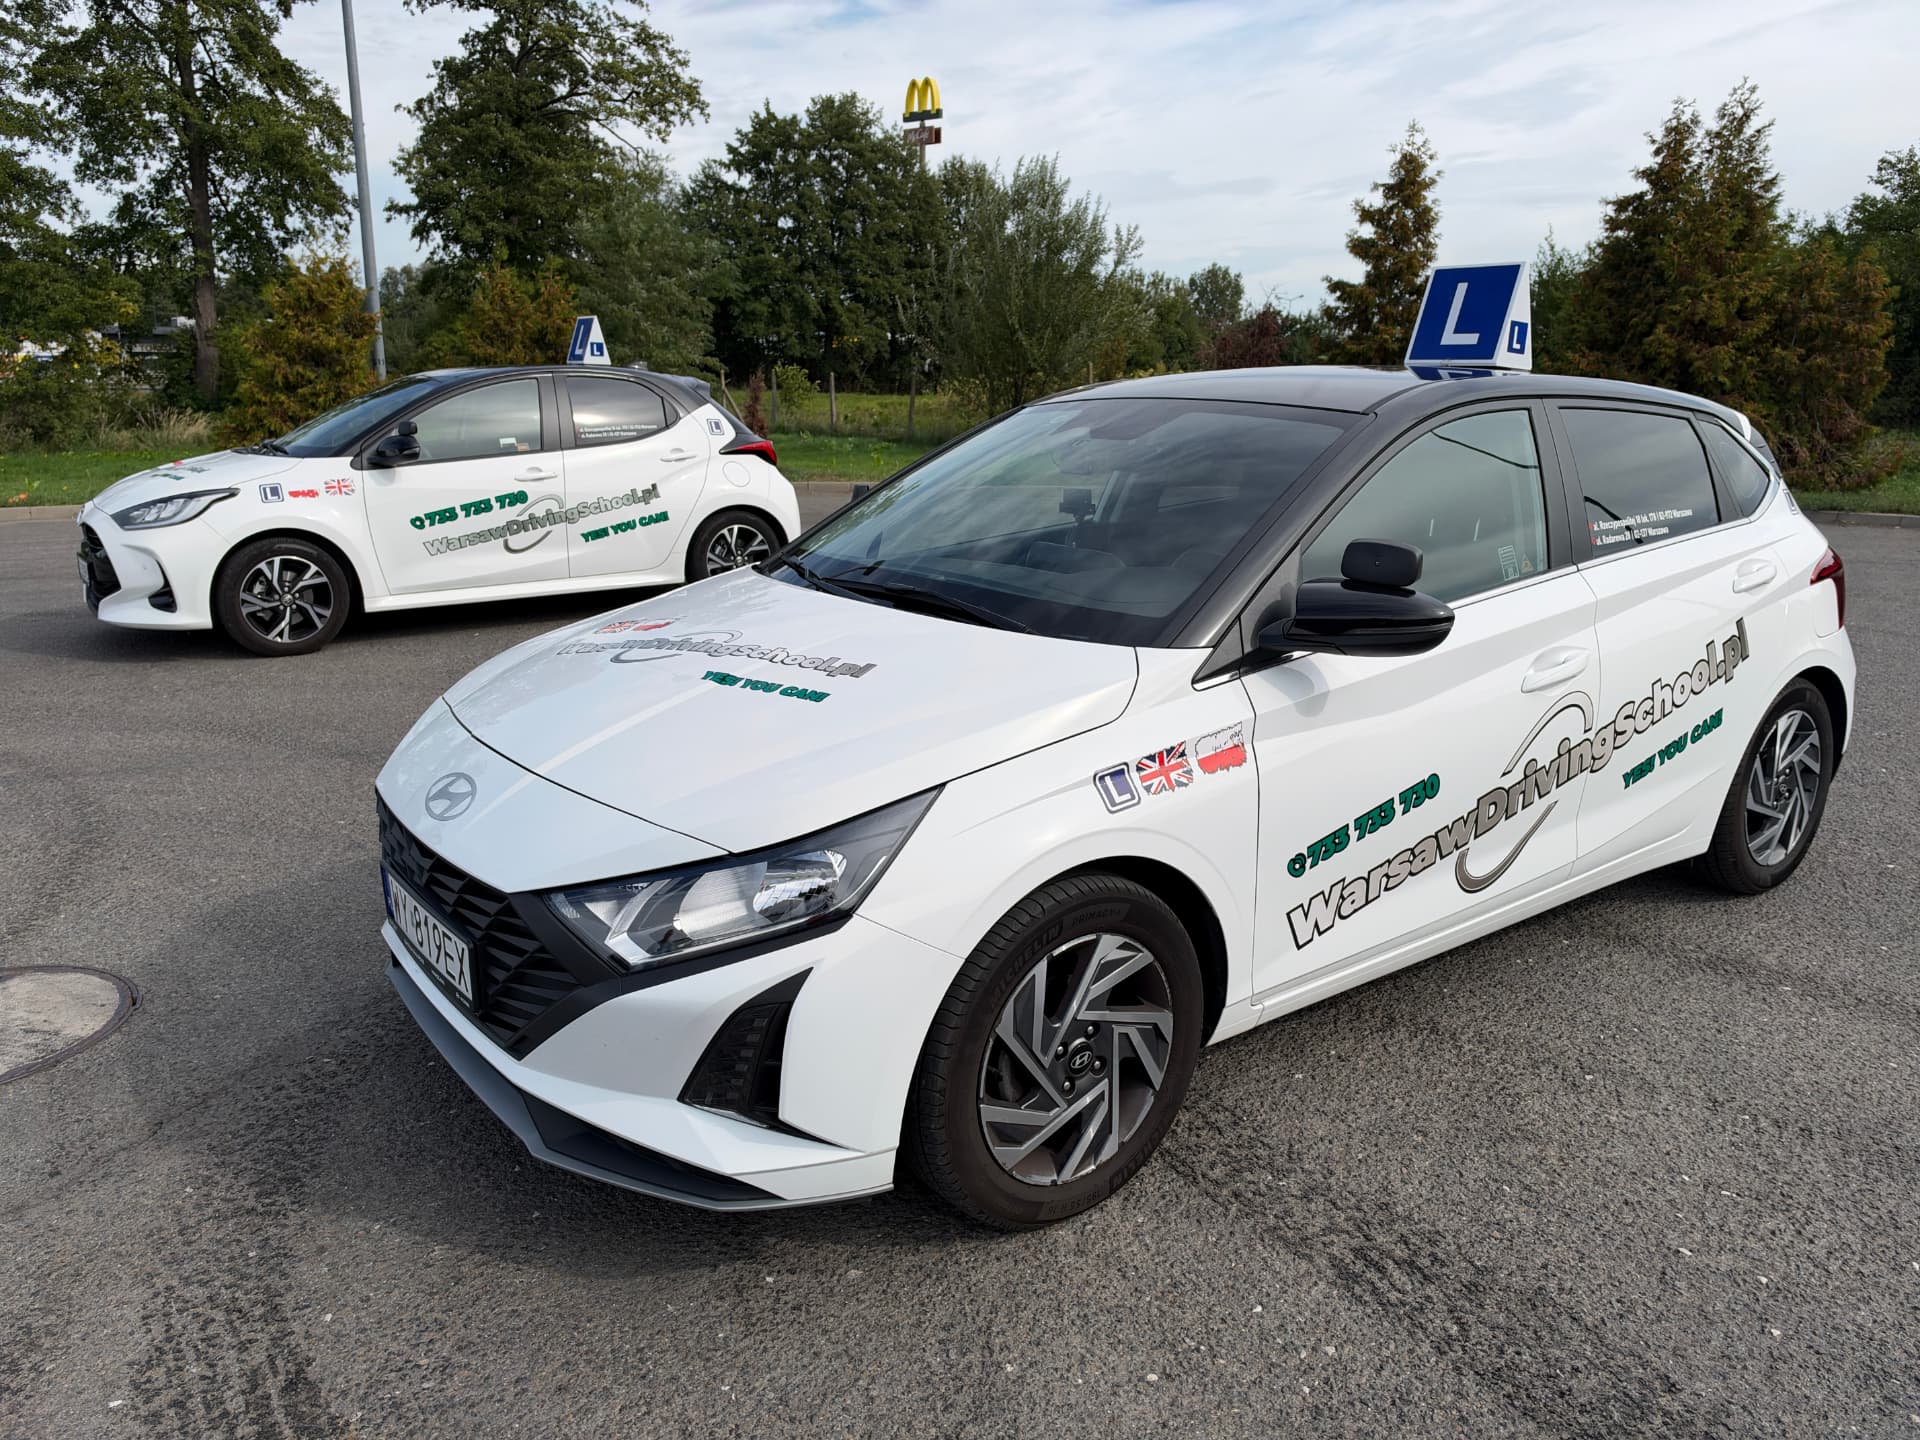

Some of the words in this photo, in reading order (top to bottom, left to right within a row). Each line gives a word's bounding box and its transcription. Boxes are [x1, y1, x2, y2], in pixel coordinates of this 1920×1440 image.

[1440, 282, 1480, 345] L
[575, 324, 585, 355] L
[593, 343, 601, 355] L
[1512, 325, 1521, 350] L
[266, 487, 279, 500] L
[423, 506, 459, 527] 733
[460, 498, 494, 518] 733
[494, 490, 529, 511] 730
[423, 483, 661, 556] WarsawDrivingSchool.pl
[609, 518, 637, 535] YOU
[740, 678, 783, 693] YOU
[1622, 753, 1657, 790] YES!
[1655, 731, 1689, 766] YOU
[1690, 707, 1724, 744] CAN!
[1104, 775, 1132, 804] L
[1286, 616, 1750, 951] WarsawDrivingSchool.pl
[1307, 823, 1351, 869] 733
[1354, 797, 1396, 842] 733
[1398, 773, 1441, 816] 730
[390, 879, 408, 933] WY
[413, 904, 469, 993] 819EX
